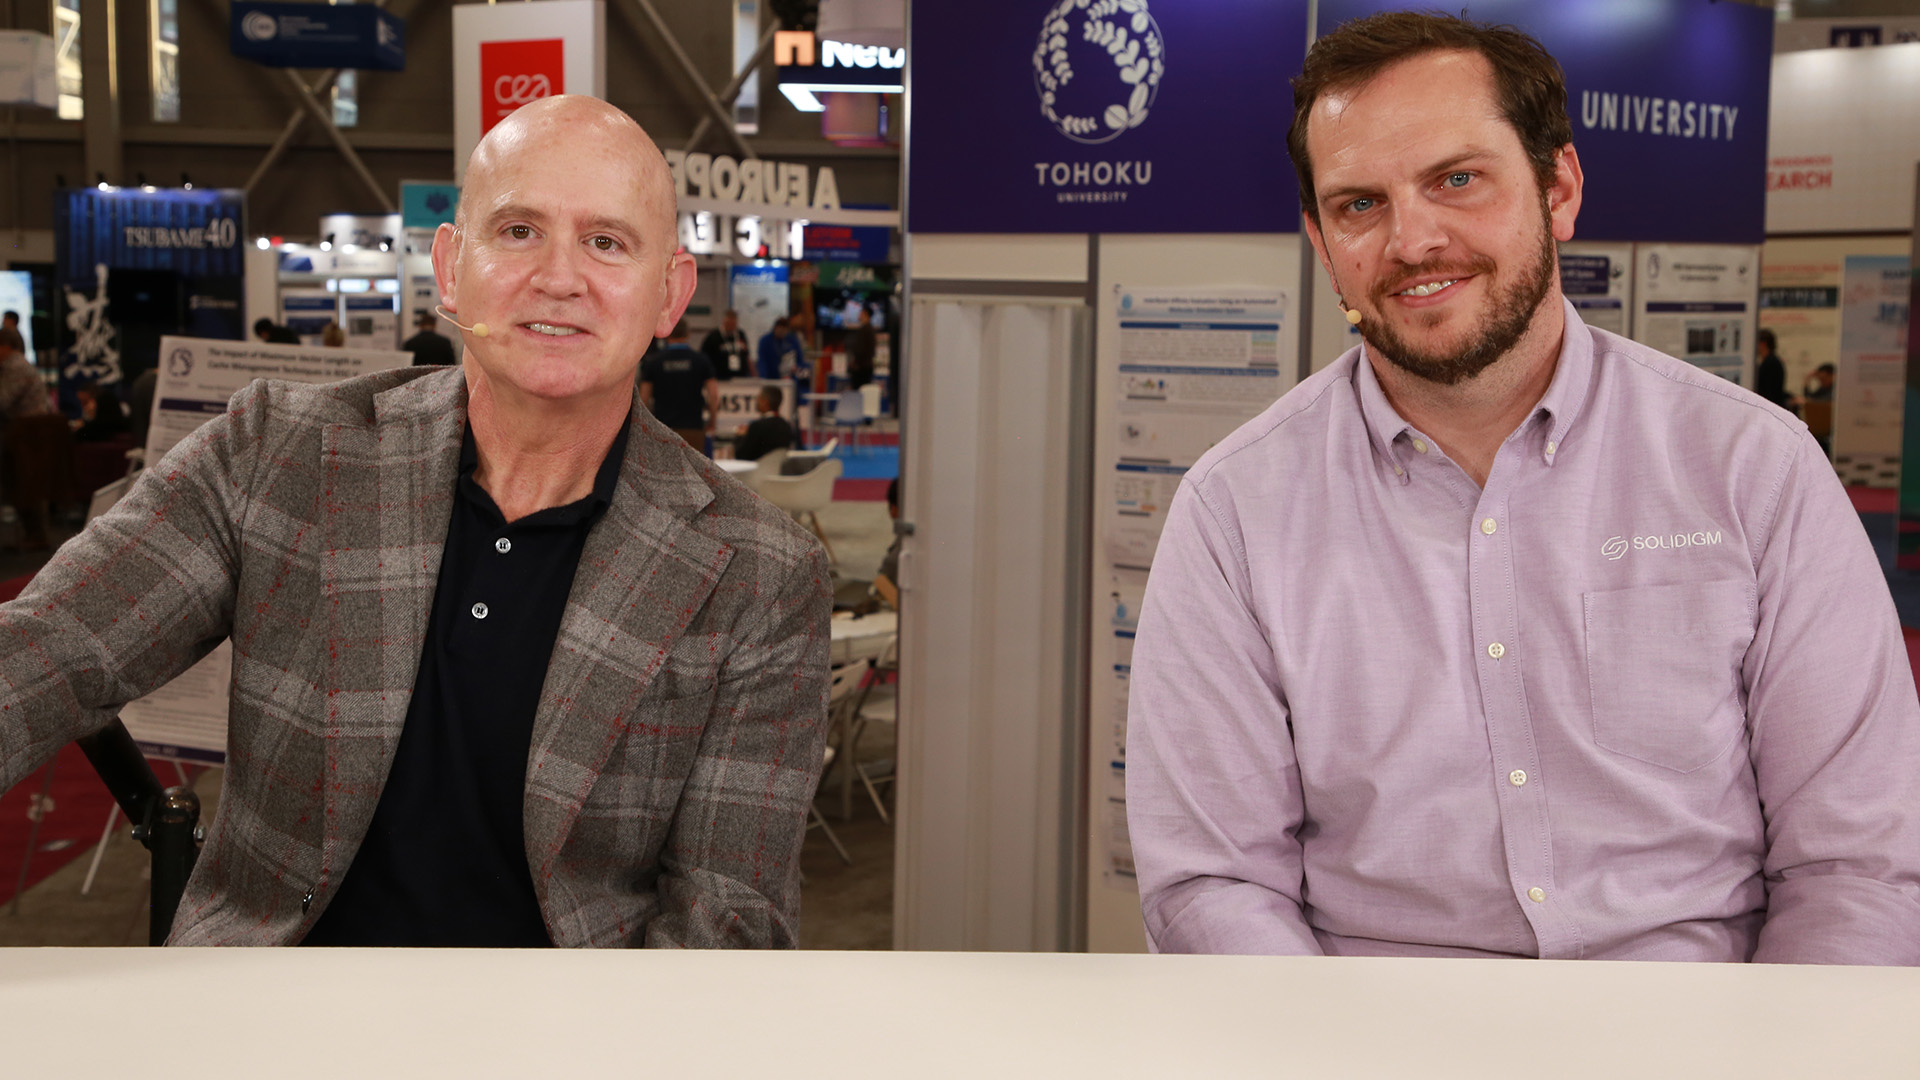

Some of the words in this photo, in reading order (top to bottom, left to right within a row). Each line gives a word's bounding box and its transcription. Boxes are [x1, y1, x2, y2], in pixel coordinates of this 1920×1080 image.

[494, 73, 551, 105] cea
[1582, 90, 1738, 141] UNIVERSITY
[1034, 160, 1152, 186] TOHOKU
[1056, 190, 1129, 203] UNIVERSITY
[208, 348, 222, 357] The
[223, 350, 249, 360] Impact
[231, 362, 279, 373] Management
[281, 365, 322, 377] Techniques
[1633, 531, 1722, 550] SOLIDIGM
